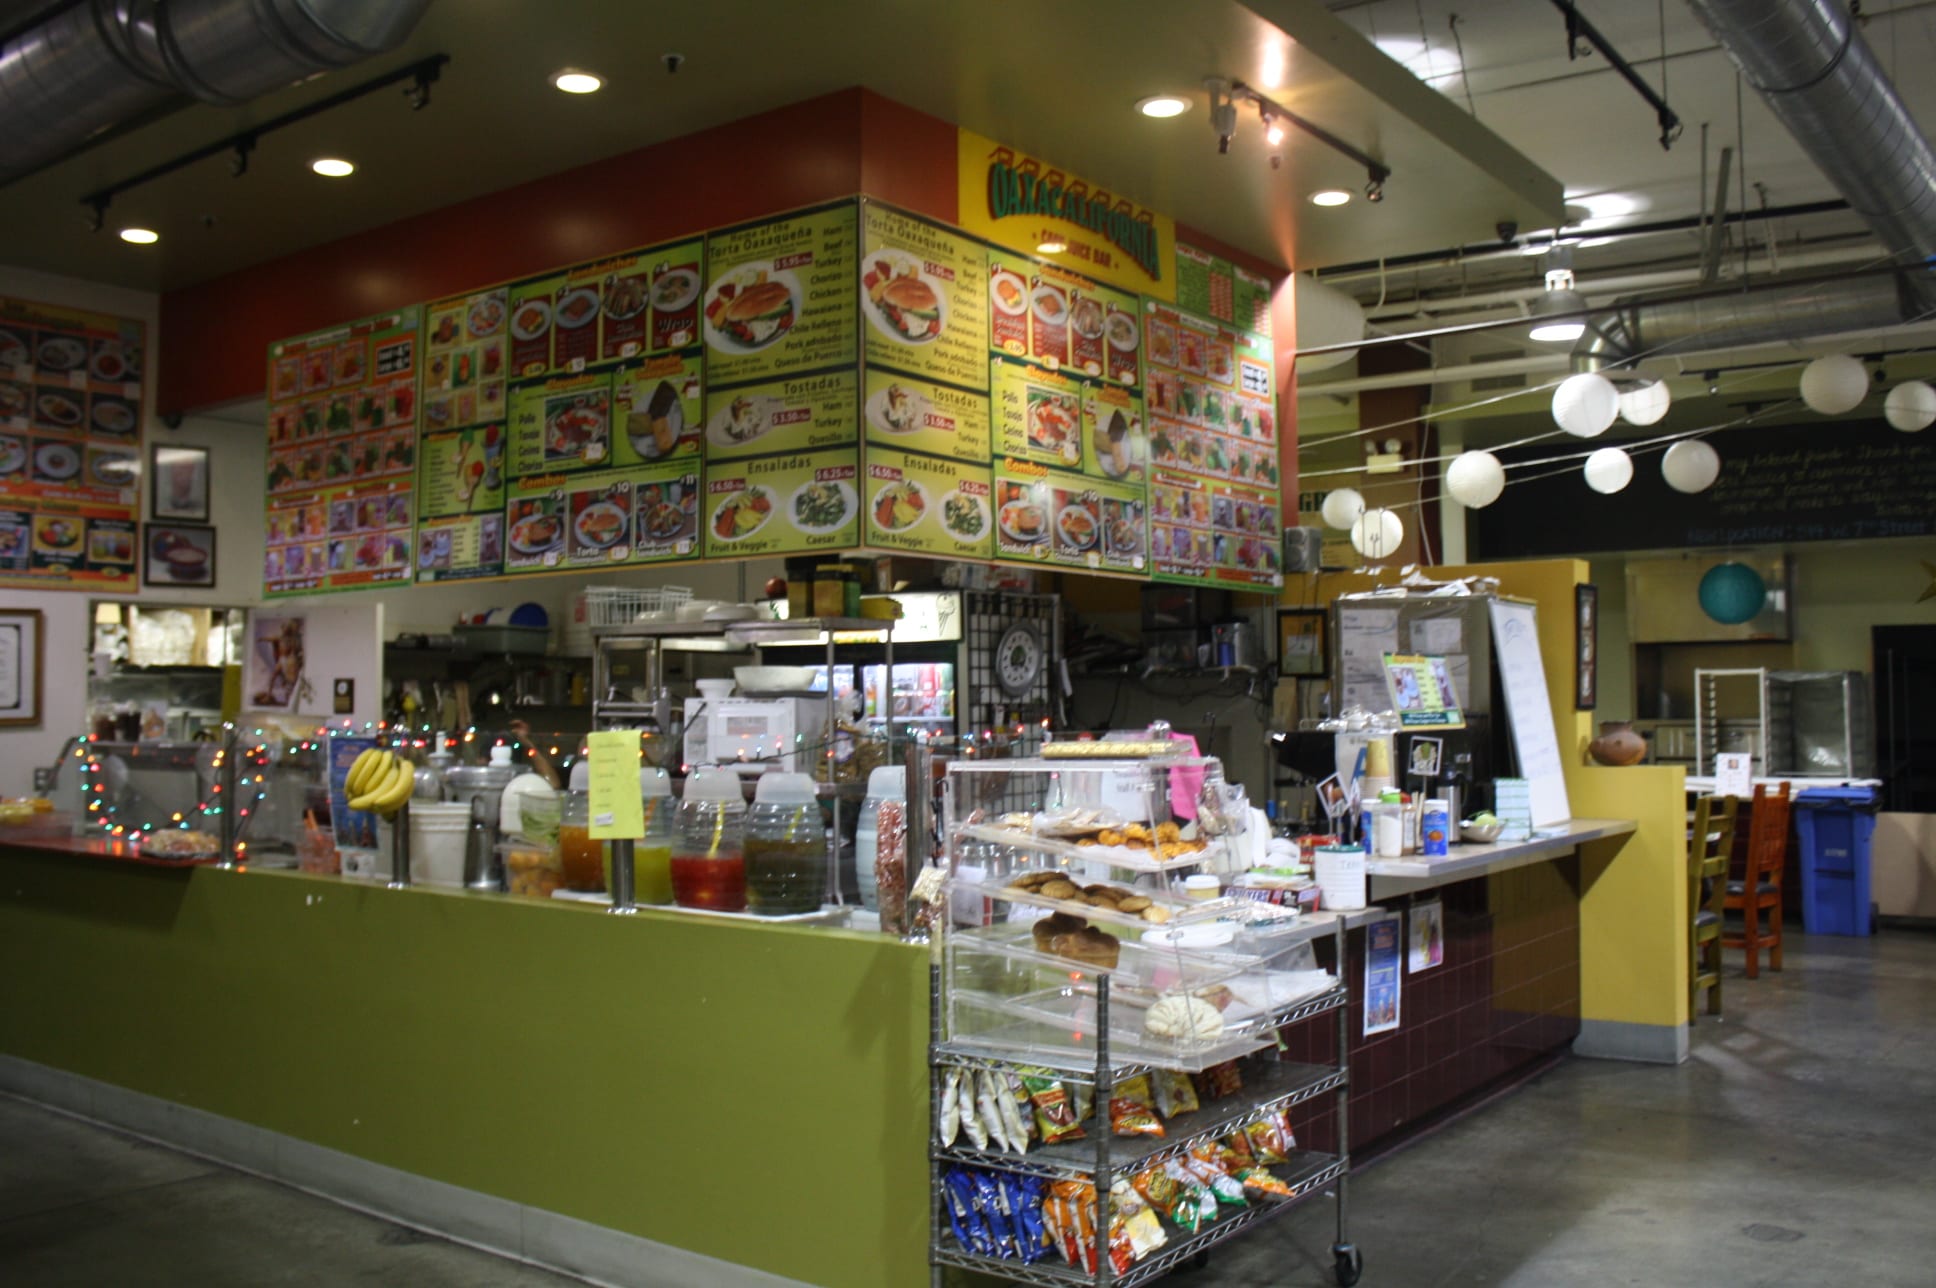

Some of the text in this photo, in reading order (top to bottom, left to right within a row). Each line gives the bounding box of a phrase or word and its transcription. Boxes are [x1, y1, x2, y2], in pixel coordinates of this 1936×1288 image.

[866, 215, 894, 234] Torta
[710, 242, 740, 257] Torta
[809, 287, 842, 300] Chicken
[784, 376, 840, 395] Tostadas
[933, 388, 977, 409] Tostadas
[747, 456, 811, 474] Ensaladas
[903, 455, 956, 476] Ensaladas
[518, 474, 567, 491] Combos
[806, 535, 836, 545] Caesar
